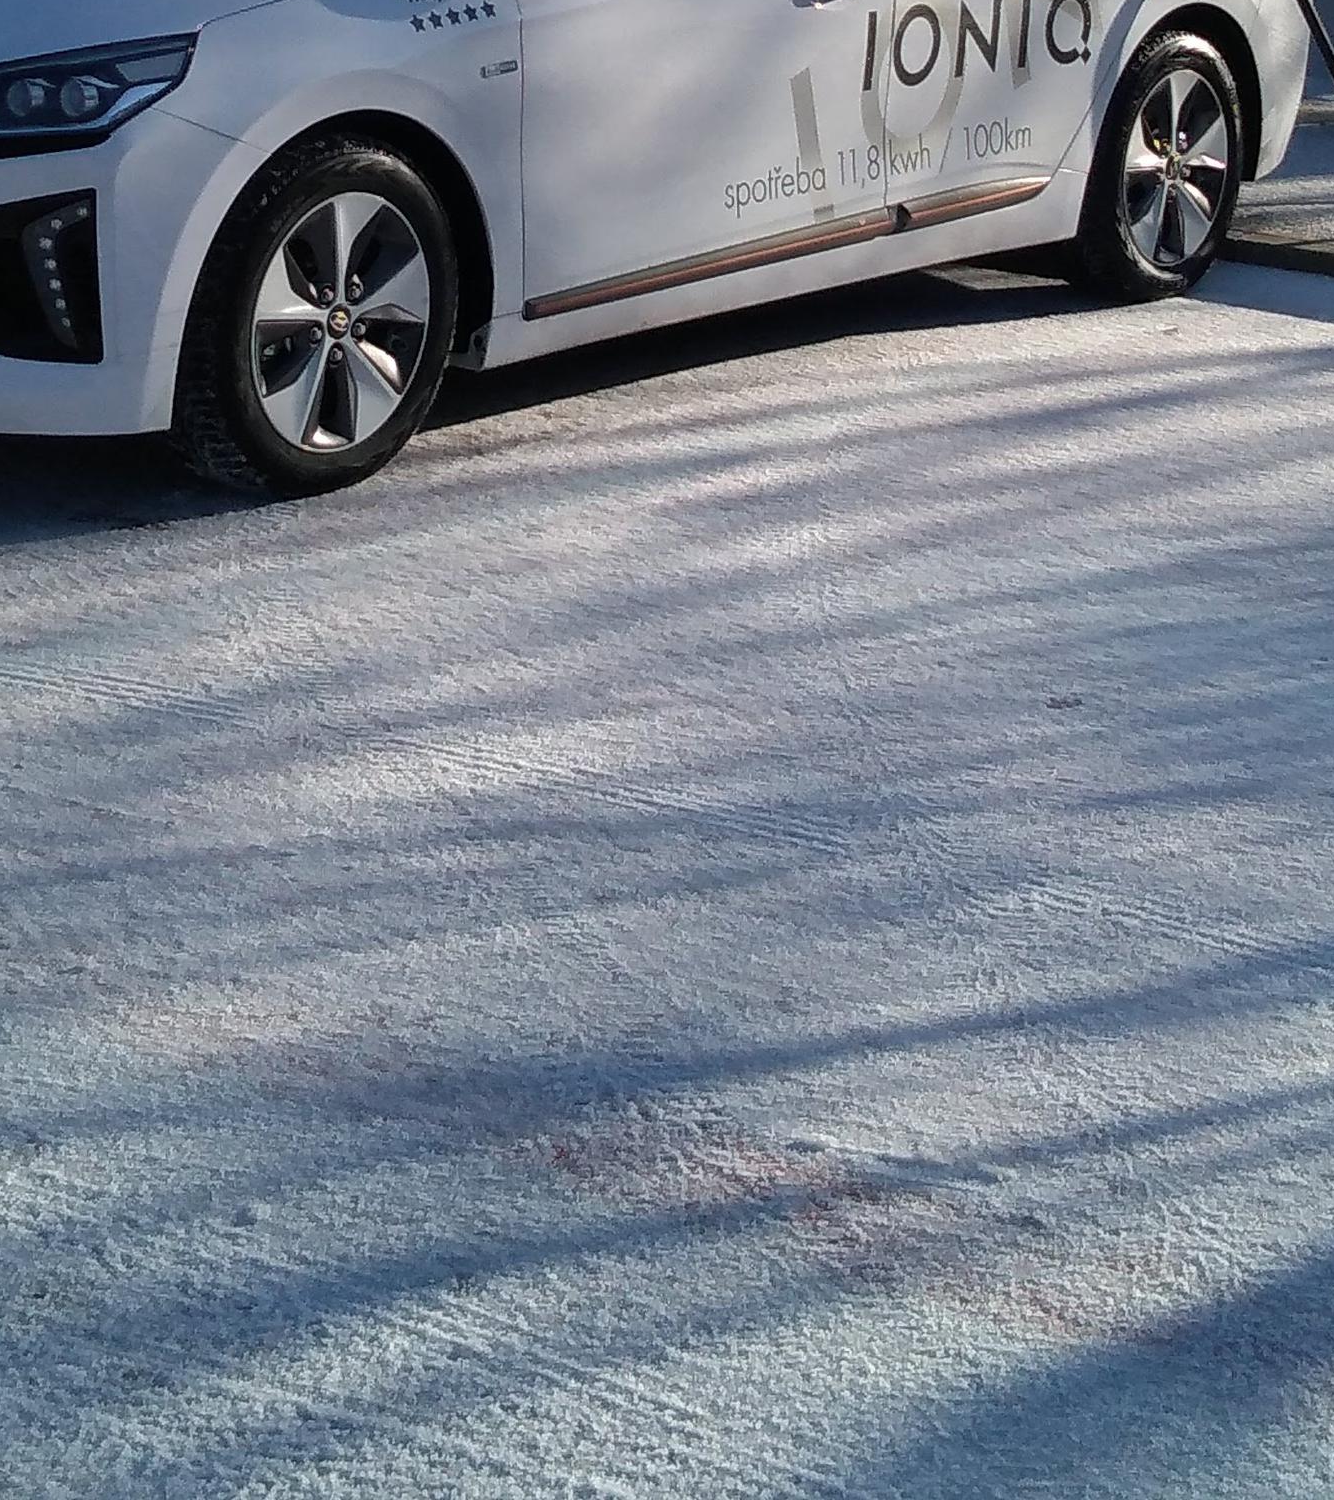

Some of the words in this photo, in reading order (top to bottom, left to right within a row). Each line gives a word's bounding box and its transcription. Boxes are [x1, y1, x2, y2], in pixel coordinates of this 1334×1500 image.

[724, 156, 827, 218] spotřeba
[836, 145, 880, 188] 11,8
[888, 132, 932, 176] kwh
